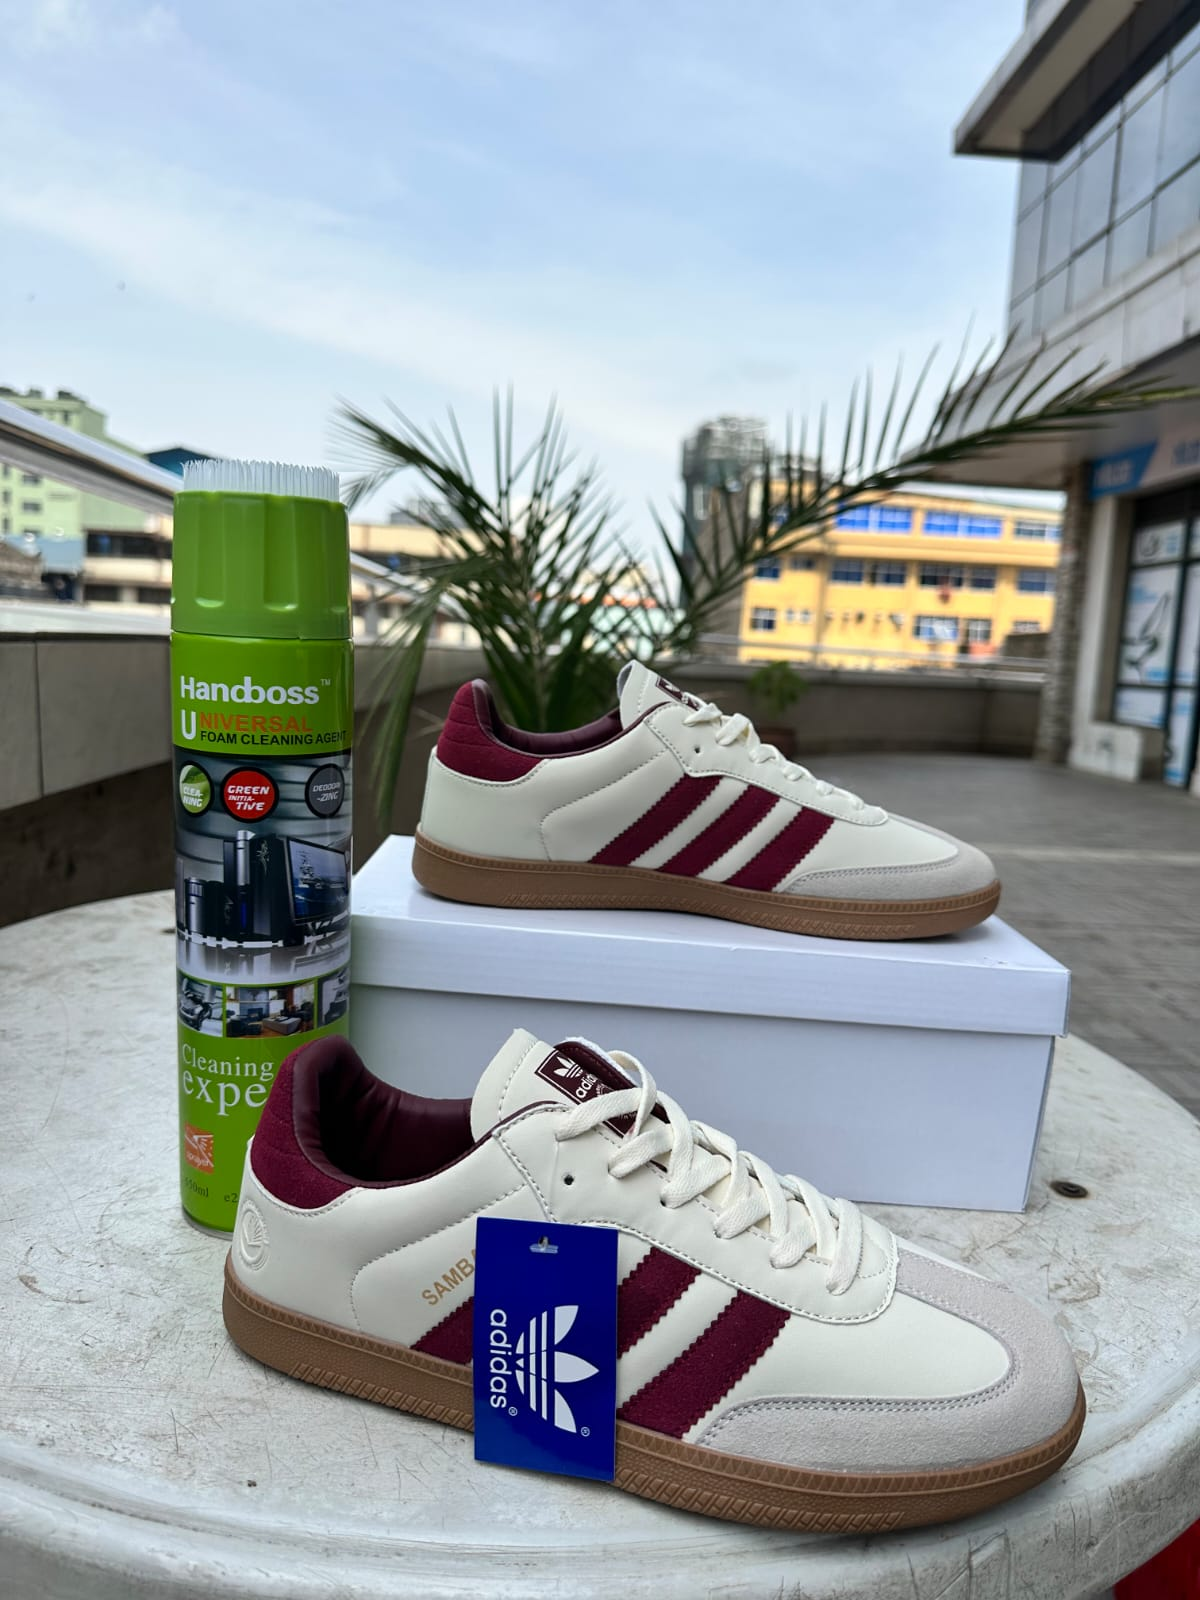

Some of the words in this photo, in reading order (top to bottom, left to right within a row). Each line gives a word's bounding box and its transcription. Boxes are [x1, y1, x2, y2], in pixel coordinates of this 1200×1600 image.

[180, 675, 319, 704] Handboss
[200, 730, 237, 744] FOAM
[241, 733, 313, 745] CLEANING
[315, 730, 347, 744] AGENT
[227, 785, 270, 795] GREEN
[236, 801, 265, 811] TIVE
[182, 1043, 275, 1082] Cleaning
[182, 1070, 272, 1117] expe
[489, 1308, 512, 1409] adidas
